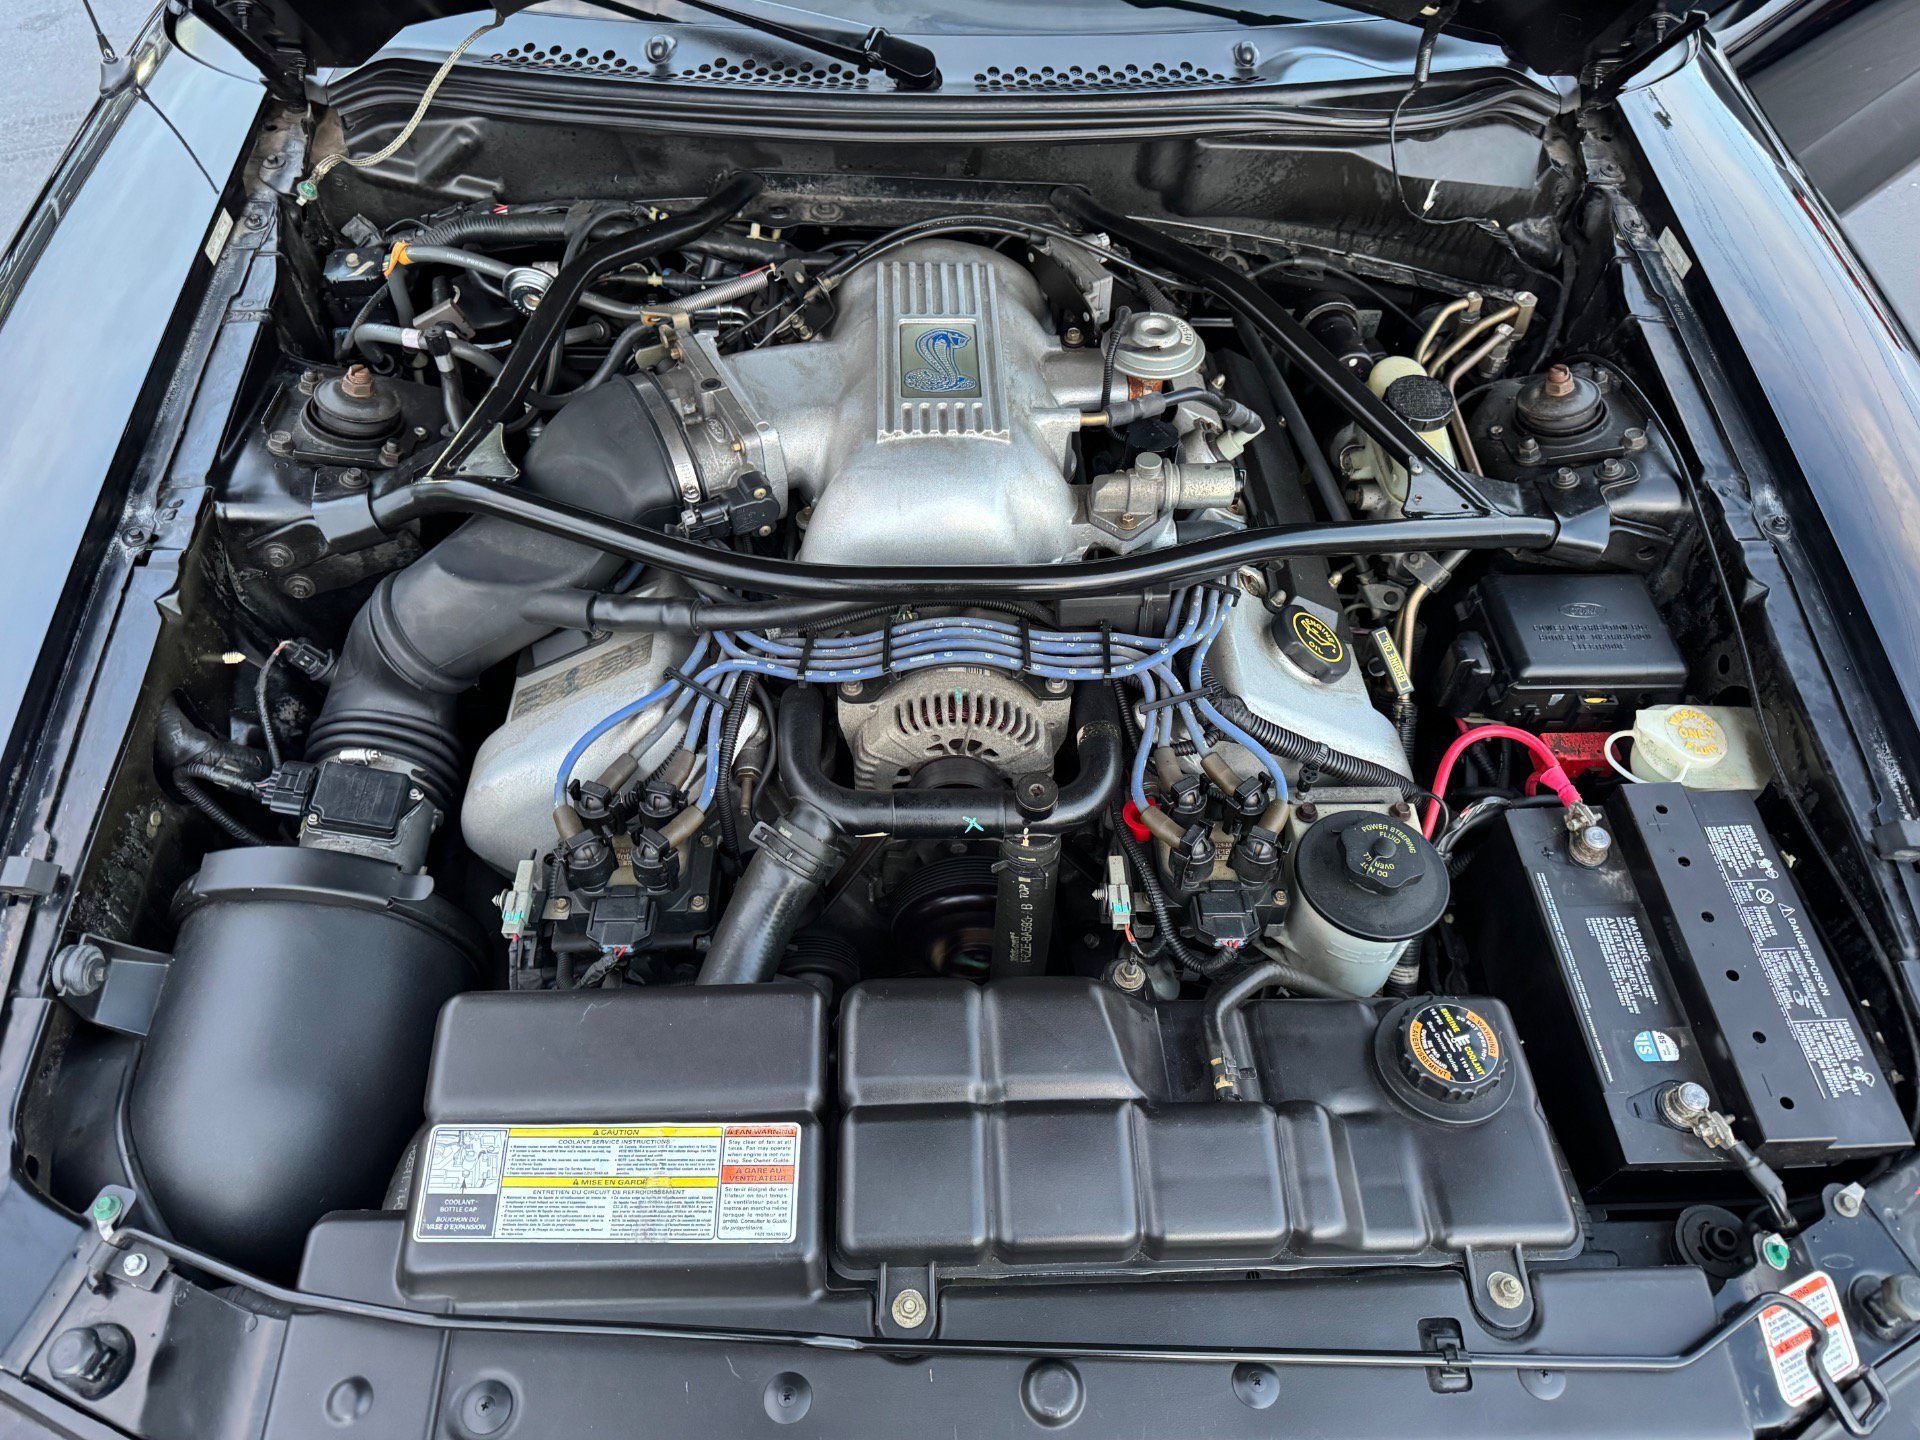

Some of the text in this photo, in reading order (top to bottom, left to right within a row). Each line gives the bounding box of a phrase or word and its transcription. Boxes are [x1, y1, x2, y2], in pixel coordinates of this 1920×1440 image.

[1308, 641, 1325, 655] OIL
[1381, 636, 1406, 683] ENGINE OIL
[1361, 823, 1417, 855] POWER STEERING
[1379, 831, 1401, 845] FLUID
[1739, 824, 1756, 852] EXPLOSIVE
[1745, 824, 1765, 857] SHIELD EYES
[1018, 883, 1031, 899] TOP
[1377, 870, 1389, 878] DO
[1626, 916, 1650, 962] WARNING
[1786, 917, 1831, 996] DANGER/POISON
[1605, 917, 1642, 998] AVERTISSEMENT
[1777, 949, 1793, 973] L'ACIDE
[1433, 1014, 1444, 1026] PSI
[1455, 1015, 1489, 1061] DO NOT OPEN HOT
[1477, 1019, 1496, 1055] WARNING
[1412, 1029, 1448, 1078] AVERTISSEMENT
[1426, 1021, 1459, 1073] See Owner Guide
[1440, 1007, 1486, 1077] ENGINE COOLANT
[1634, 1031, 1653, 1055] SIL
[1793, 1023, 1816, 1062] RAPIDEMENT
[1800, 1022, 1821, 1058] CONSULTER
[1818, 1031, 1833, 1054] RINCER
[1828, 1021, 1851, 1060] WITH WATER
[1835, 1021, 1859, 1062] IMMEDIATELY
[1841, 1020, 1864, 1057] FLUSH EYES
[1827, 1034, 1844, 1061] MEDICAL
[1840, 1062, 1853, 1078] HELP
[1848, 1079, 1861, 1096] FAST
[426, 1223, 487, 1231] VASE D'EXPANSION
